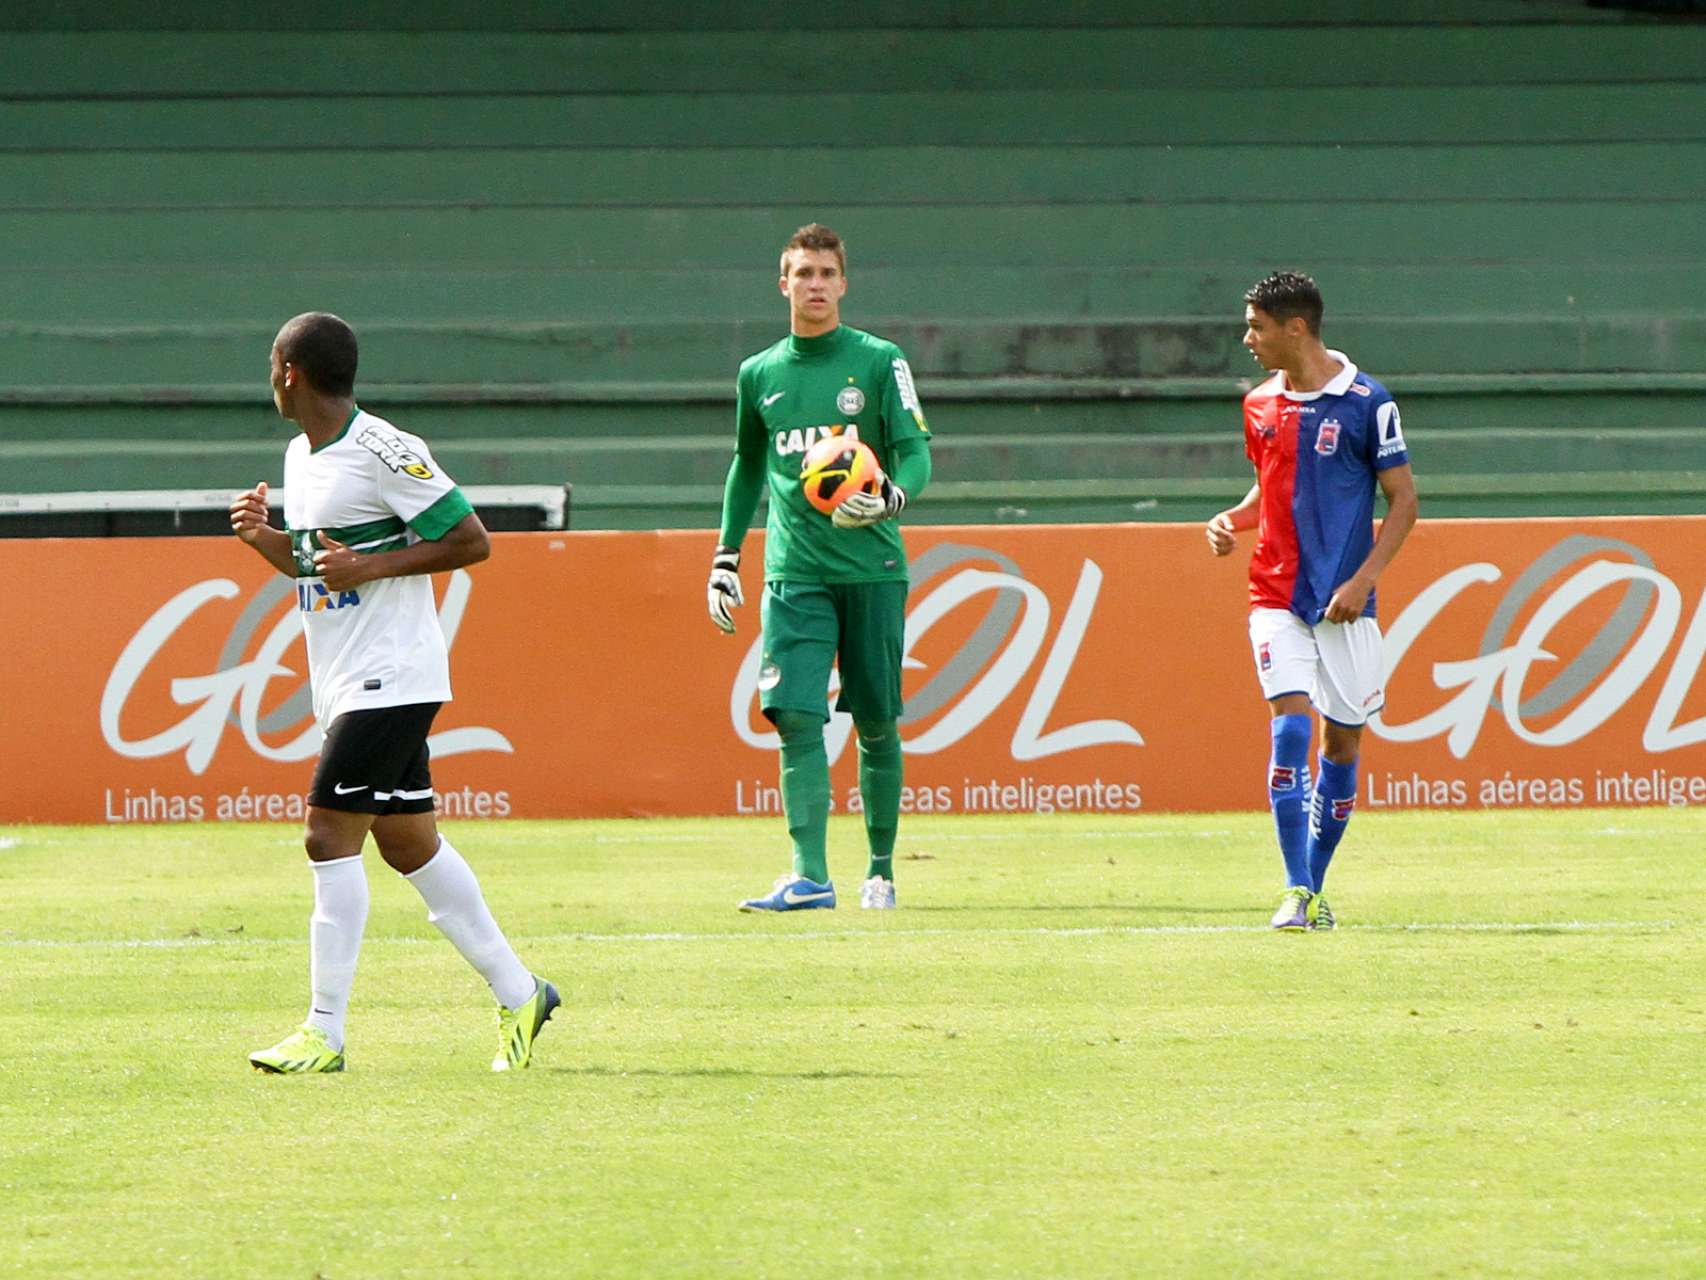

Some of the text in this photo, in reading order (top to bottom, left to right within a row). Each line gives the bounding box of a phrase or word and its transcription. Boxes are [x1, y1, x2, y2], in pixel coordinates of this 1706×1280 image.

[105, 785, 309, 821] Linhas aérea
[847, 785, 952, 812] aeas
[963, 777, 1142, 815] inteligentes
[1367, 773, 1467, 806] Linhas
[1479, 770, 1585, 803] aéreas
